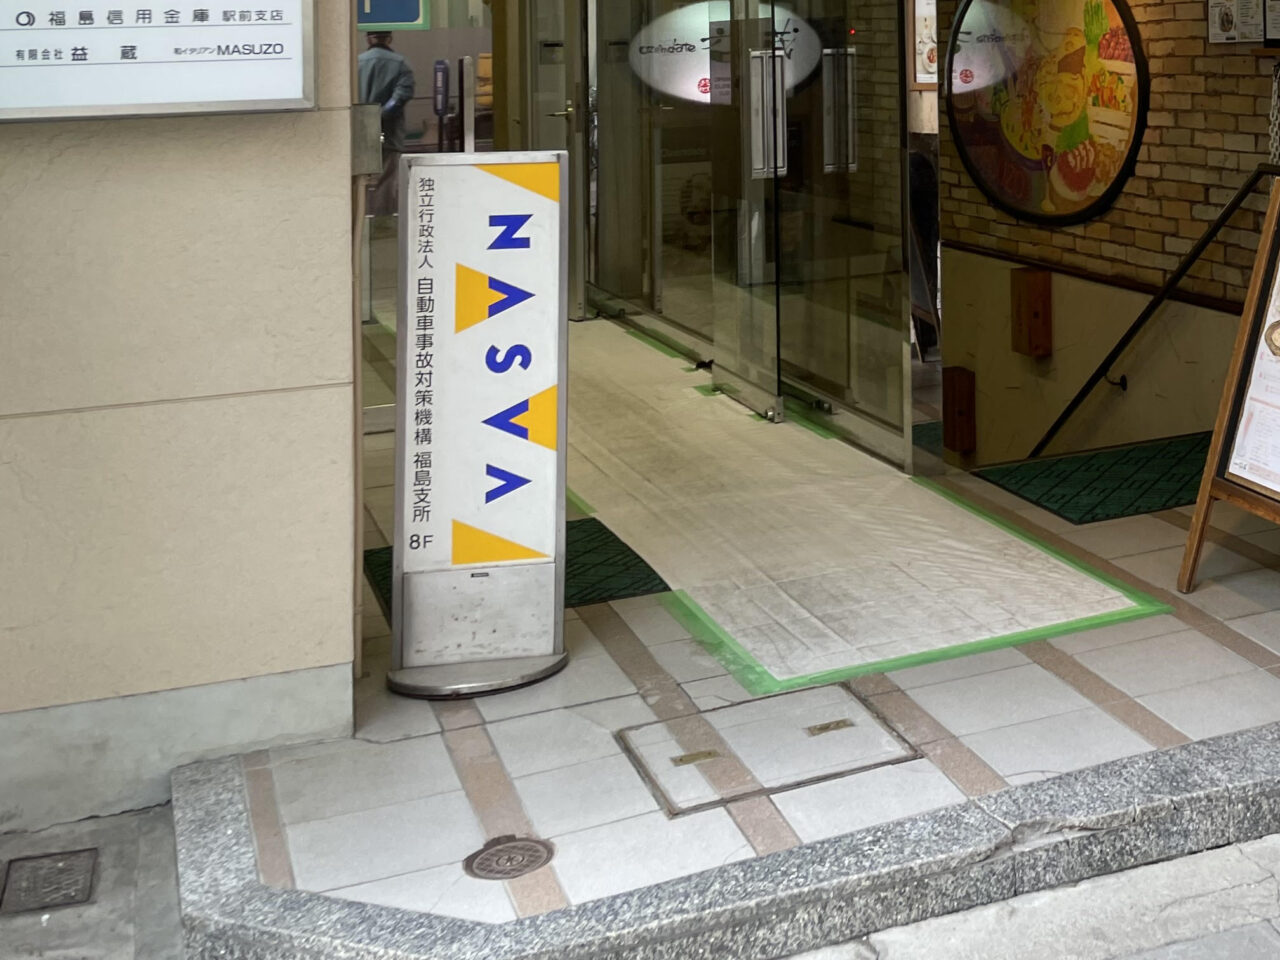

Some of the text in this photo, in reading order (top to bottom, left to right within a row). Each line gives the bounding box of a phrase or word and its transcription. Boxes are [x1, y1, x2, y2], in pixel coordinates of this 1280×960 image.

[413, 177, 435, 523] 独立行政法人 自動車事故対策機構 福島支所
[409, 534, 434, 550] 8F
